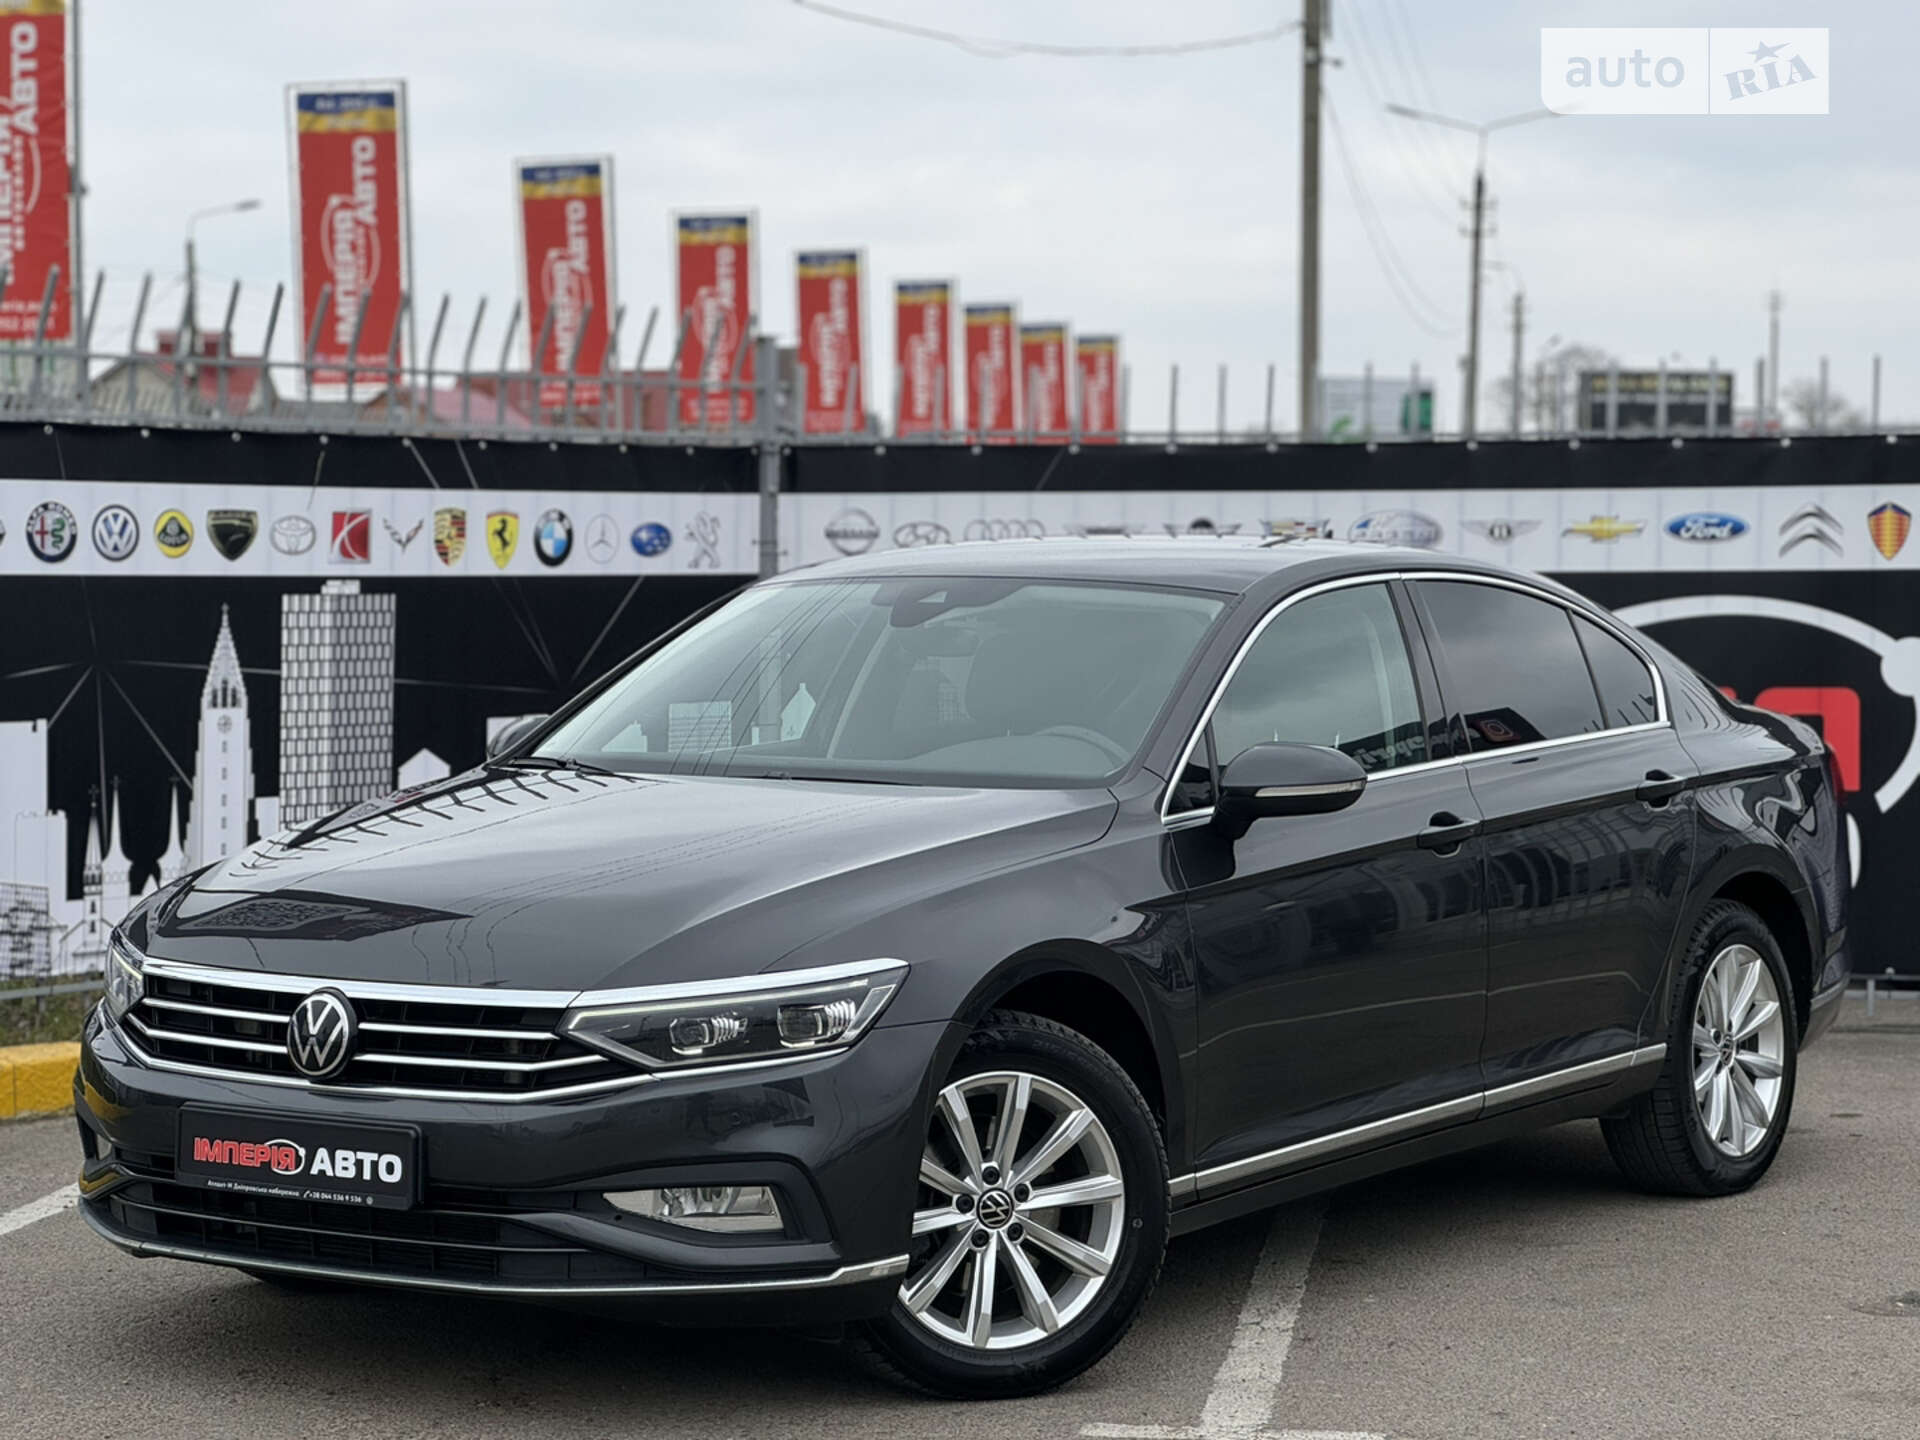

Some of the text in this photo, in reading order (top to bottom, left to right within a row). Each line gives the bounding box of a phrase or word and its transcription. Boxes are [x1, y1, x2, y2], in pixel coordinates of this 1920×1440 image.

[11, 22, 38, 135] АВТО
[352, 136, 376, 225] АВТО
[1680, 516, 1734, 538] Ford
[194, 1137, 402, 1183] ІМПЕРІЯ АВТО
